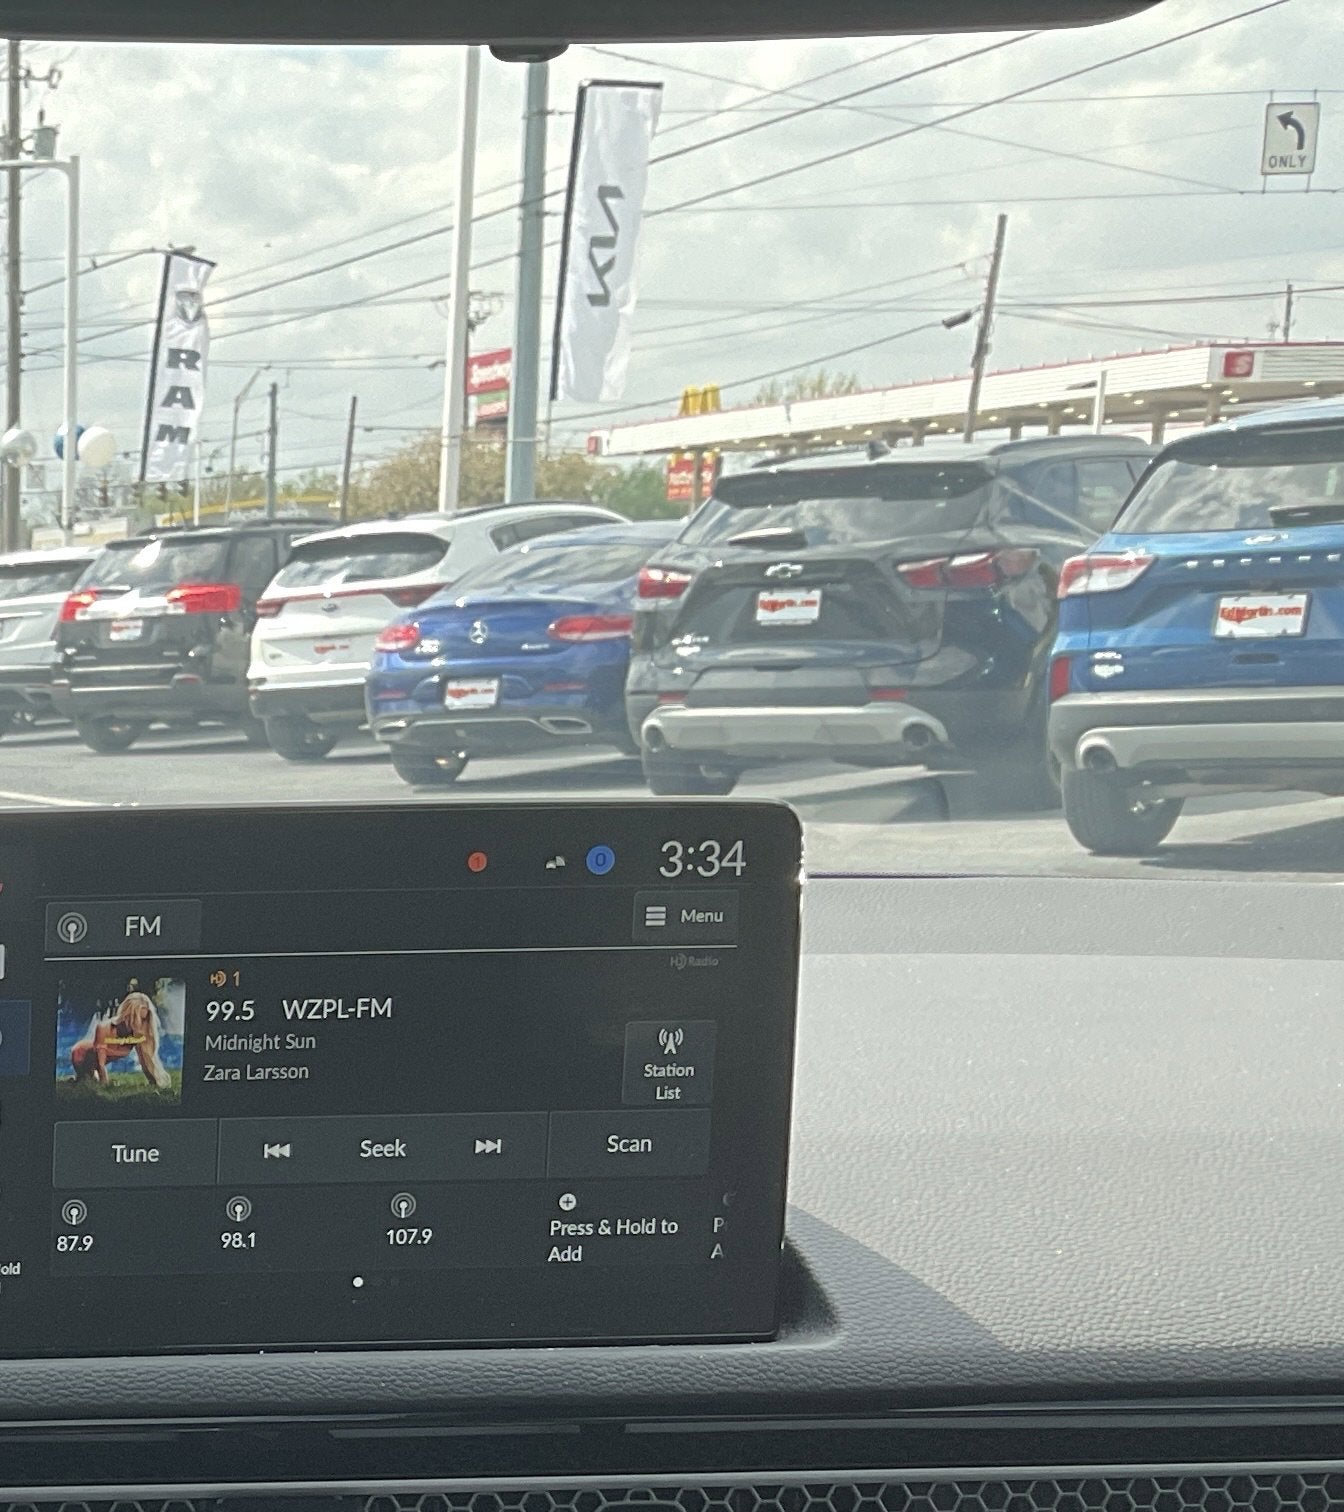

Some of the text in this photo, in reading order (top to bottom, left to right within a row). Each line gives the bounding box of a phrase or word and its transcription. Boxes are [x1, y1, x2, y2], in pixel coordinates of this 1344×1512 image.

[1268, 156, 1307, 169] ONLY
[155, 348, 201, 445] RAM
[659, 840, 747, 878] 3:34
[681, 909, 724, 923] Menu
[125, 916, 161, 937] FM
[688, 957, 719, 967] Radio
[232, 971, 240, 987] 1
[205, 997, 392, 1022] 99.5 WZPL-FM
[205, 1033, 316, 1053] Midnight Sun
[203, 1063, 309, 1082] Zara Larsson
[643, 1064, 695, 1079] Station
[655, 1086, 681, 1100] List
[360, 1139, 407, 1158] Seek
[607, 1135, 652, 1153] Scan
[112, 1145, 160, 1163] Tune
[550, 1218, 679, 1237] Press & Hold to
[56, 1235, 94, 1252] 87.9
[221, 1232, 256, 1249] 98.1
[386, 1228, 433, 1246] 107.9
[547, 1245, 582, 1262] Add
